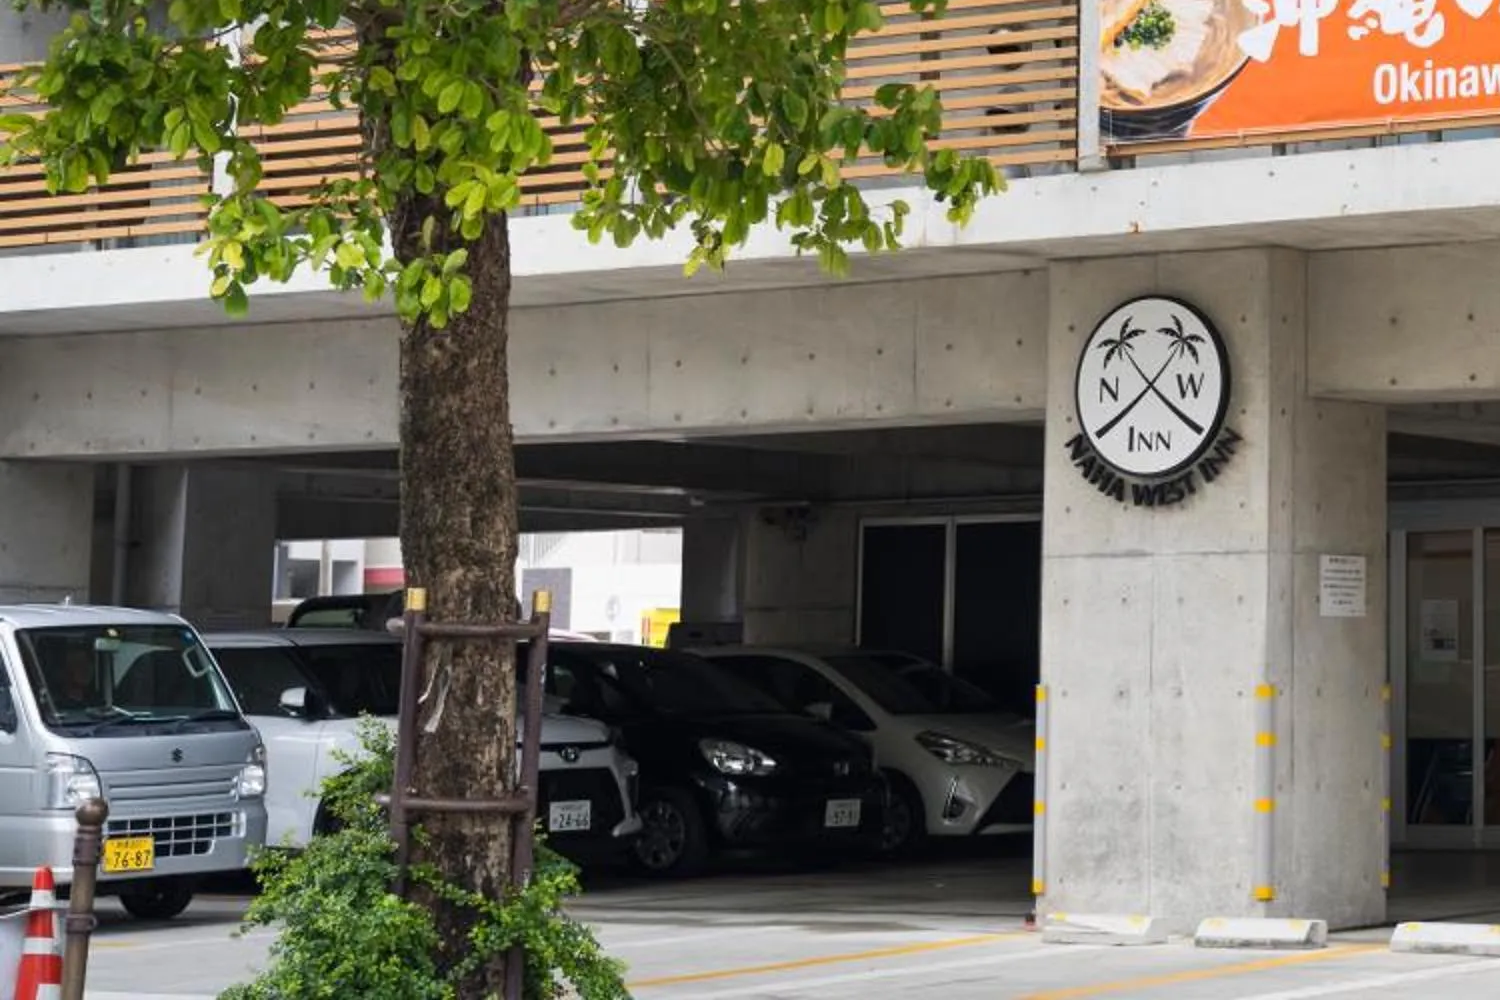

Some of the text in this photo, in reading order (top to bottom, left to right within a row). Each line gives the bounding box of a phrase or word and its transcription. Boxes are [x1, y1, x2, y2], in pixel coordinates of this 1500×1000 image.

[1099, 376, 1119, 404] N
[1176, 372, 1205, 400] W
[1128, 425, 1171, 453] INN
[1064, 426, 1244, 507] NAHA WEST INN
